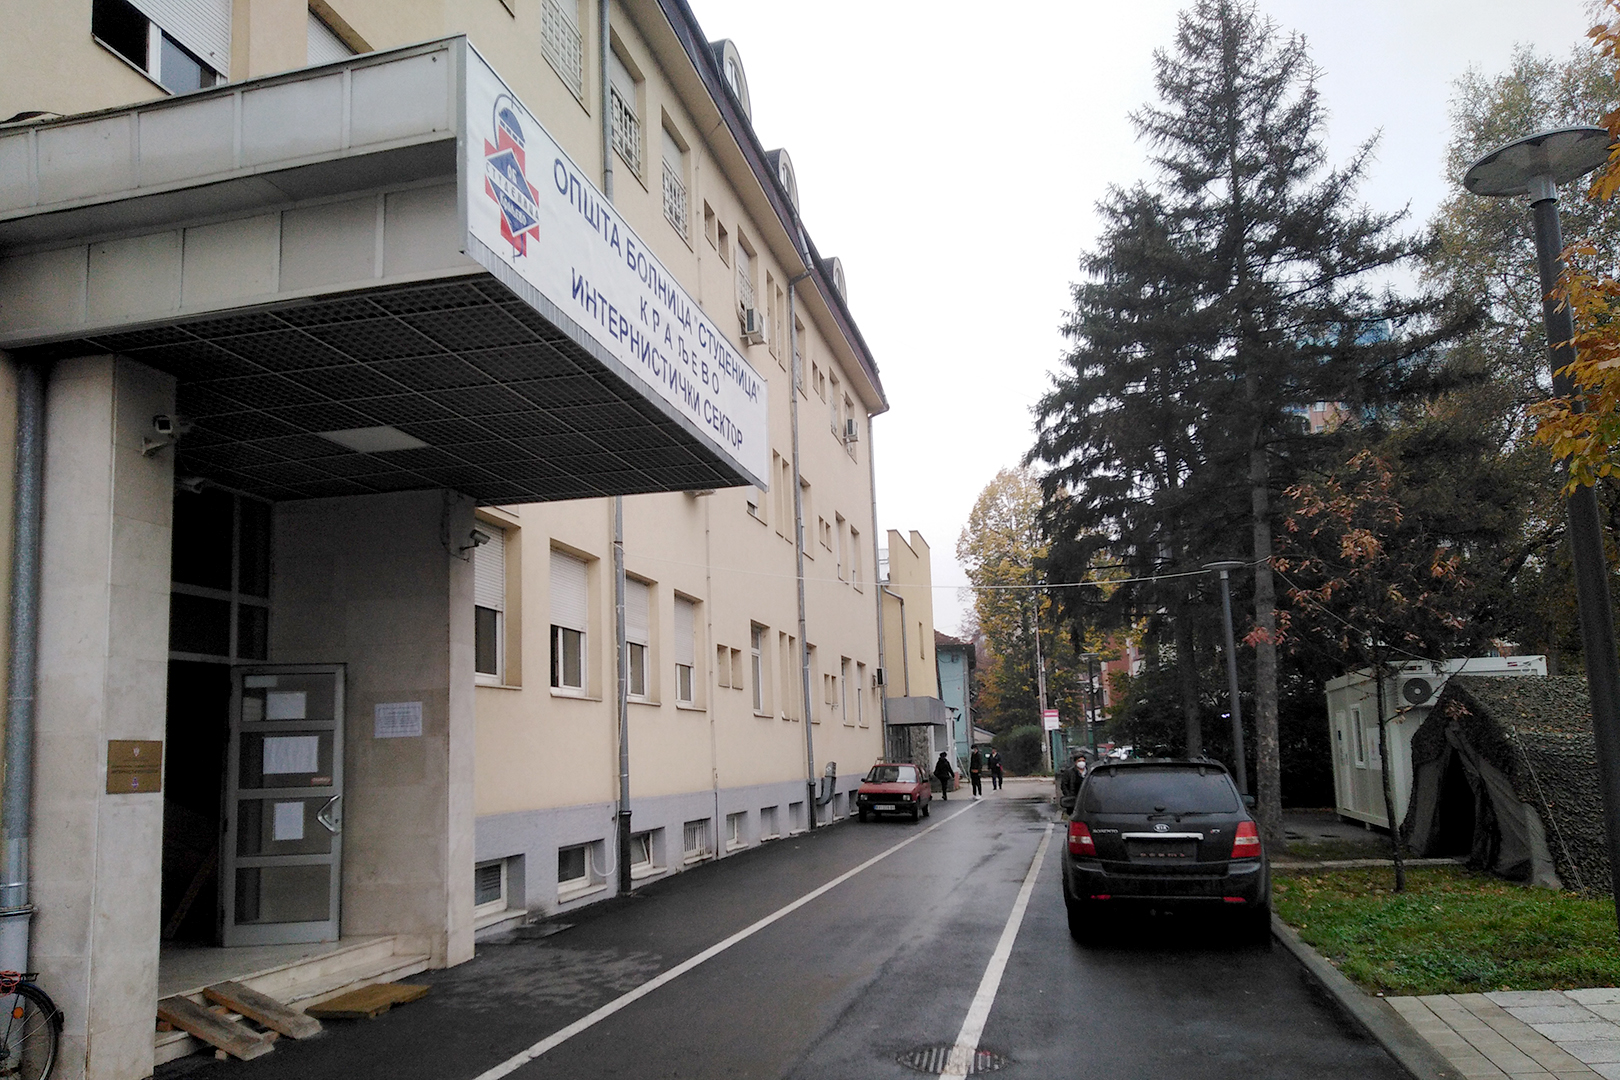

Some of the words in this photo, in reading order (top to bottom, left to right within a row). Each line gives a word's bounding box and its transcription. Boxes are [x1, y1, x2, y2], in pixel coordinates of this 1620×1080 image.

[553, 157, 622, 258] ОПШТА
[626, 237, 692, 335] БОЛНИЦА
[571, 267, 701, 416] ИНТЕРНИСТИЧКИ
[703, 398, 743, 451] СЕКТОР
